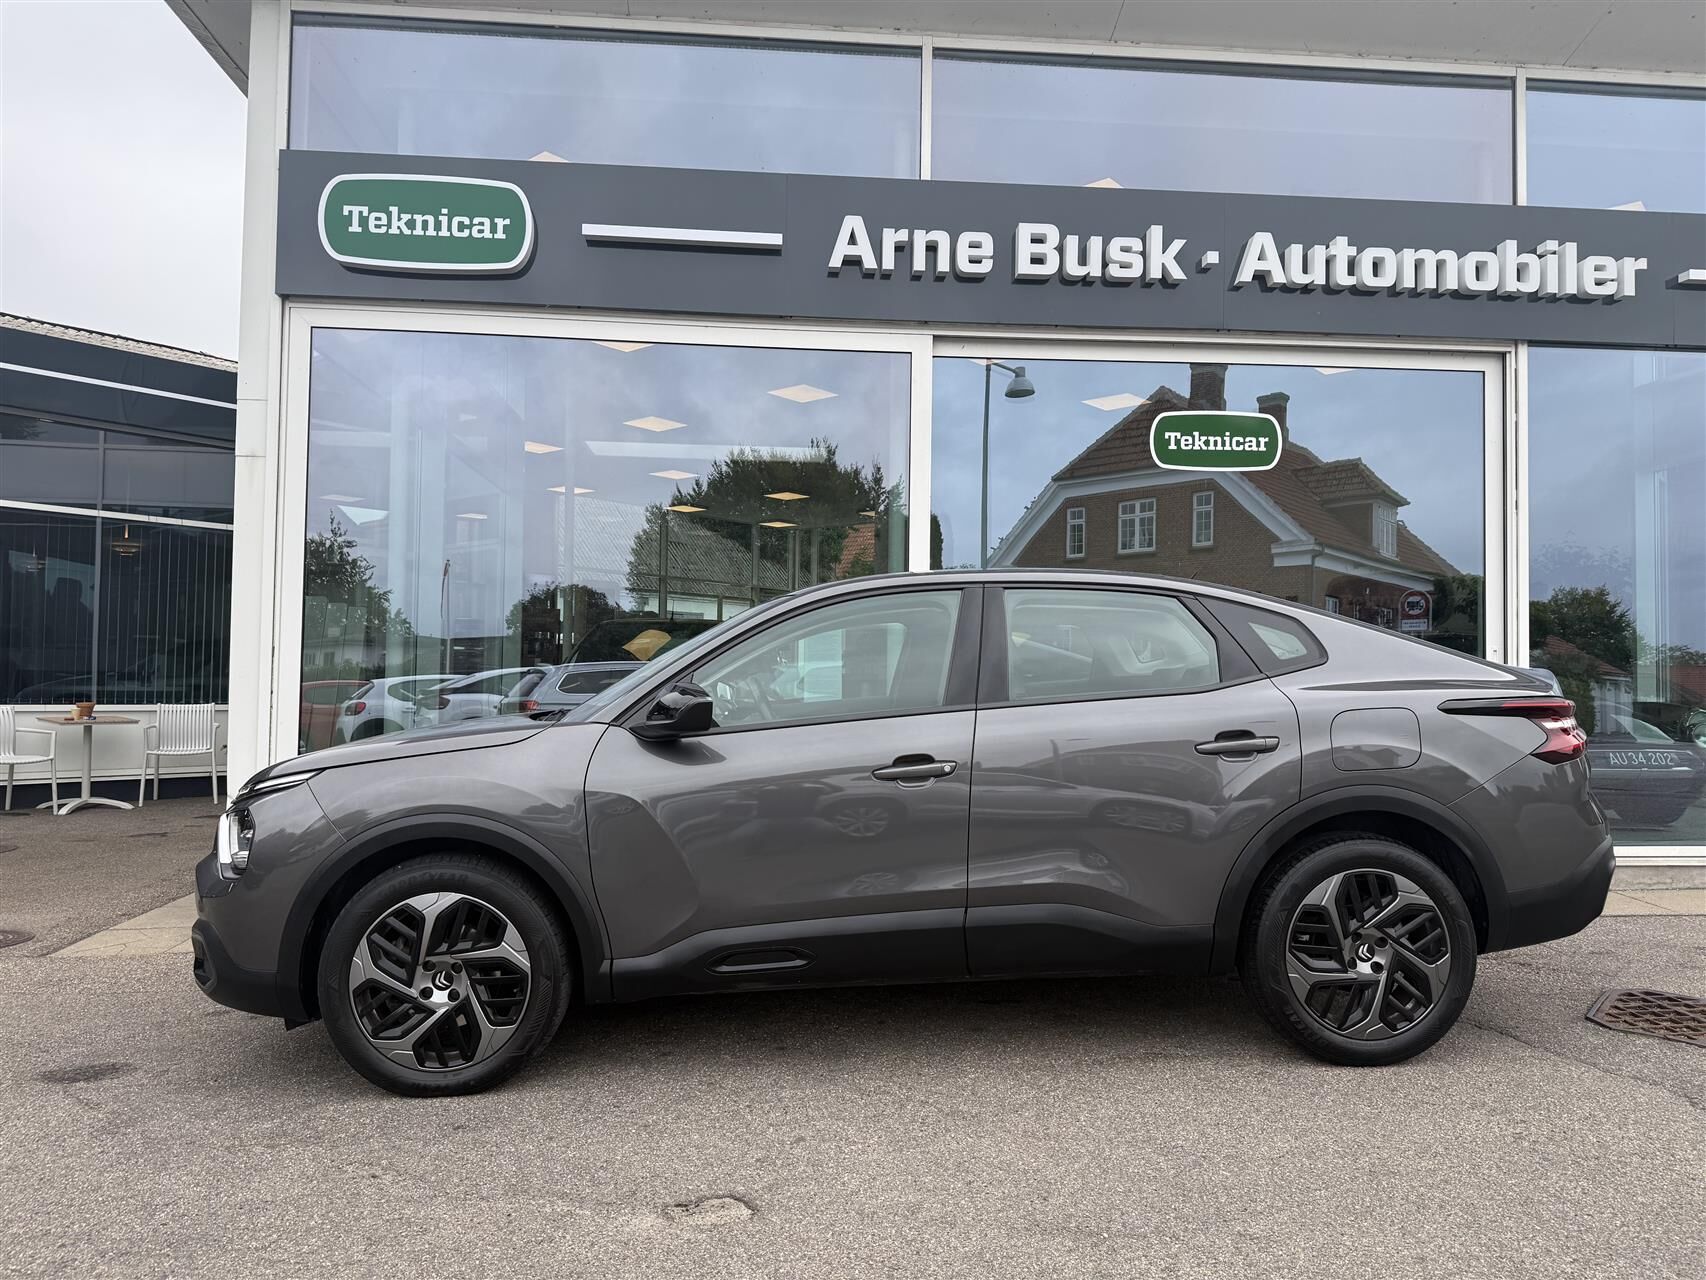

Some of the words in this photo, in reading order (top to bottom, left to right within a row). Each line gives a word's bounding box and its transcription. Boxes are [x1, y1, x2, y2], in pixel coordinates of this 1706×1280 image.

[343, 205, 510, 239] Teknicar
[827, 214, 994, 276] Arne
[1014, 222, 1188, 284] Busk
[1233, 231, 1647, 299] Automobiler
[1164, 431, 1269, 451] Teknicar
[1609, 752, 1628, 765] AU
